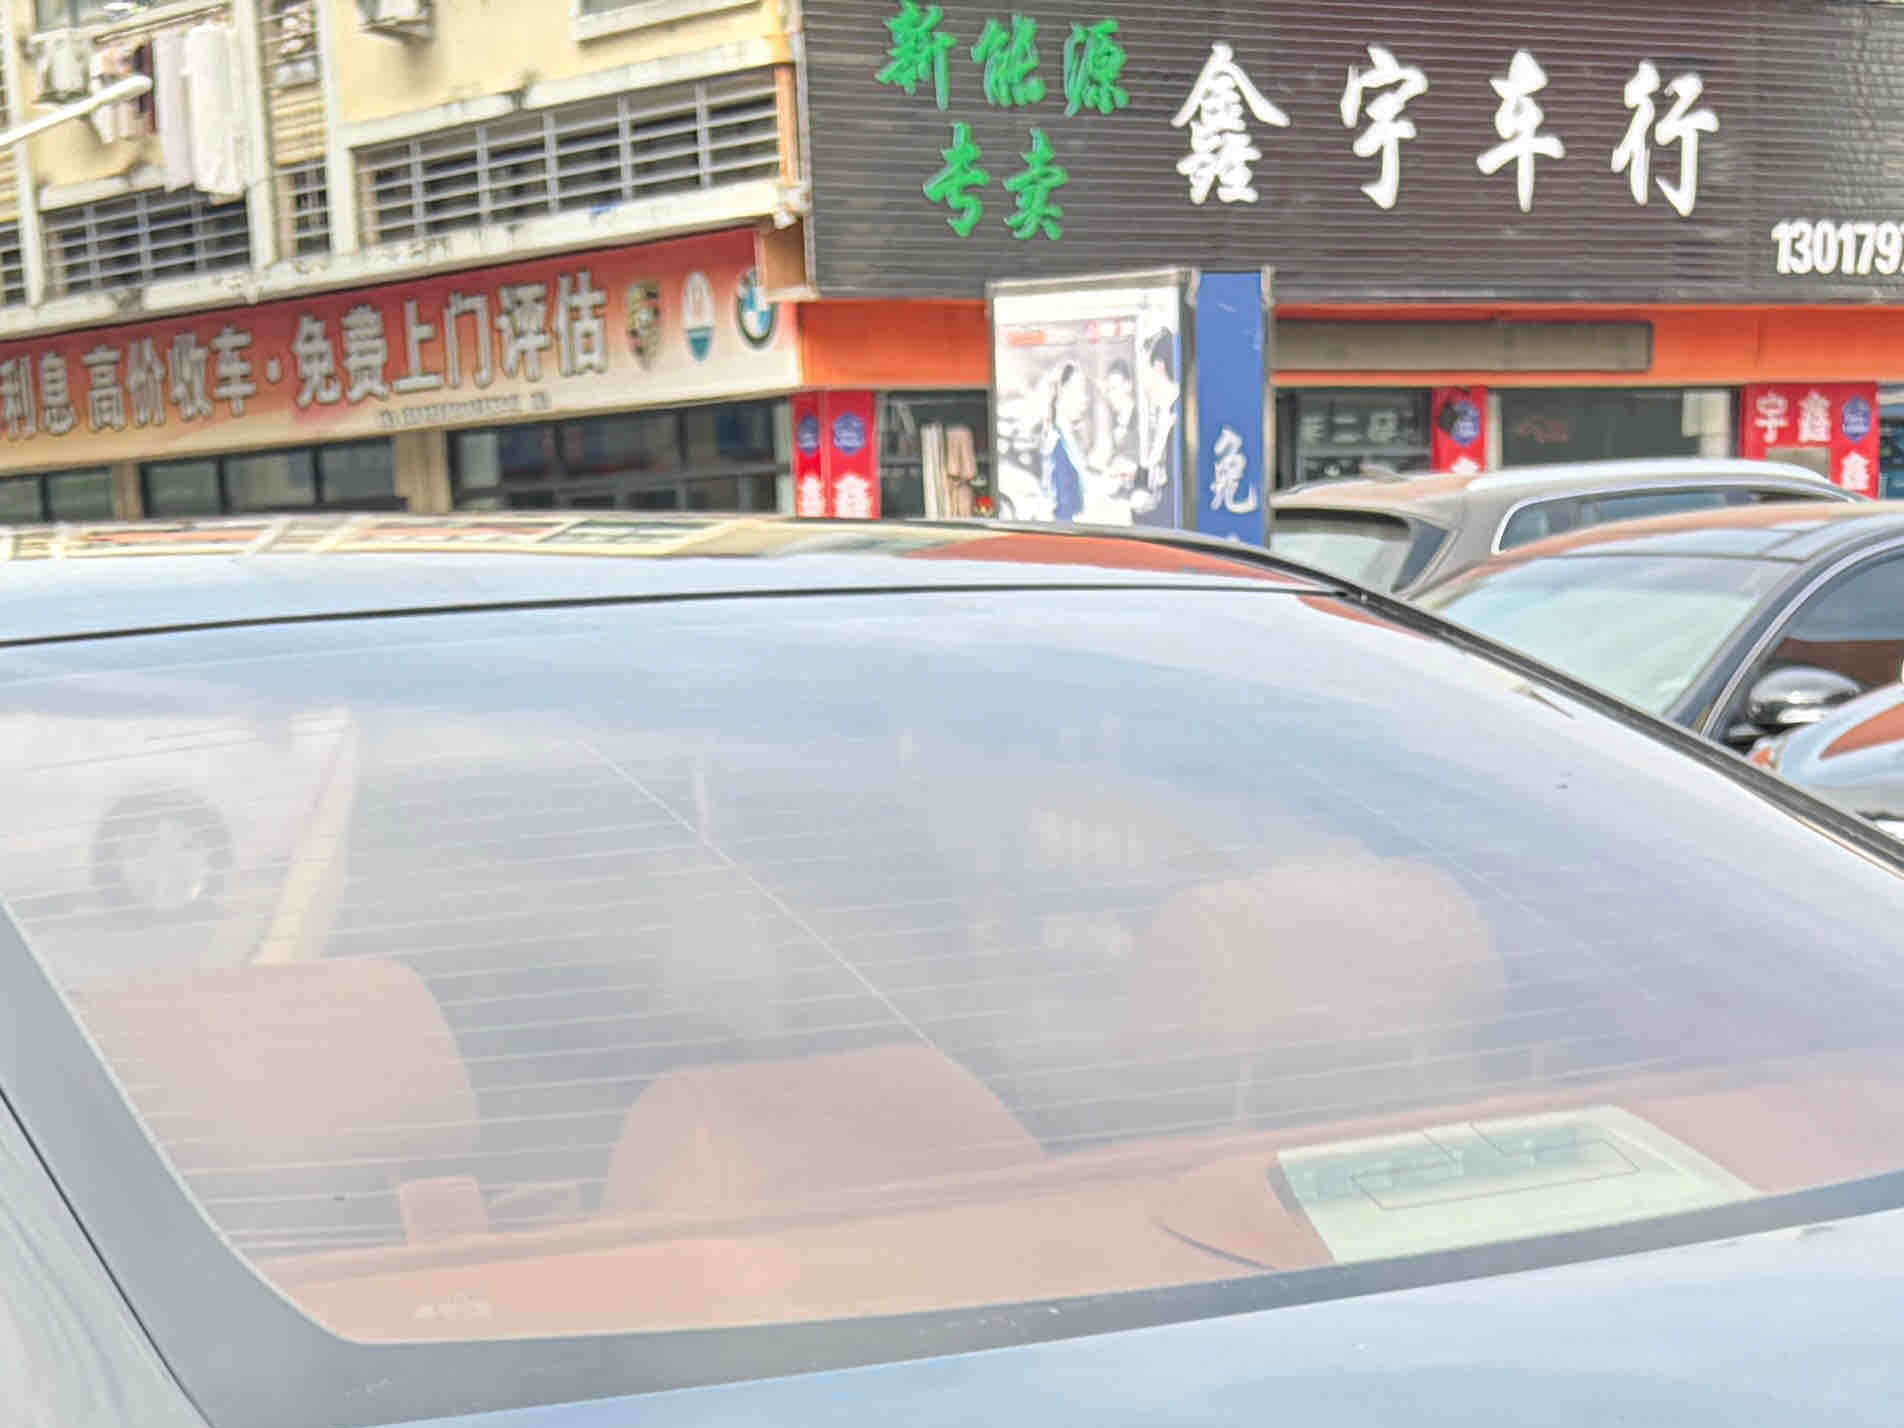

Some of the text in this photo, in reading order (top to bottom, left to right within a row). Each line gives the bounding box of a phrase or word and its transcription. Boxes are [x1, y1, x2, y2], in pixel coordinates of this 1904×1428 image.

[875, 0, 1129, 117] 新能源
[922, 122, 1069, 240] 专卖
[1170, 41, 1719, 216] 鑫宇车行
